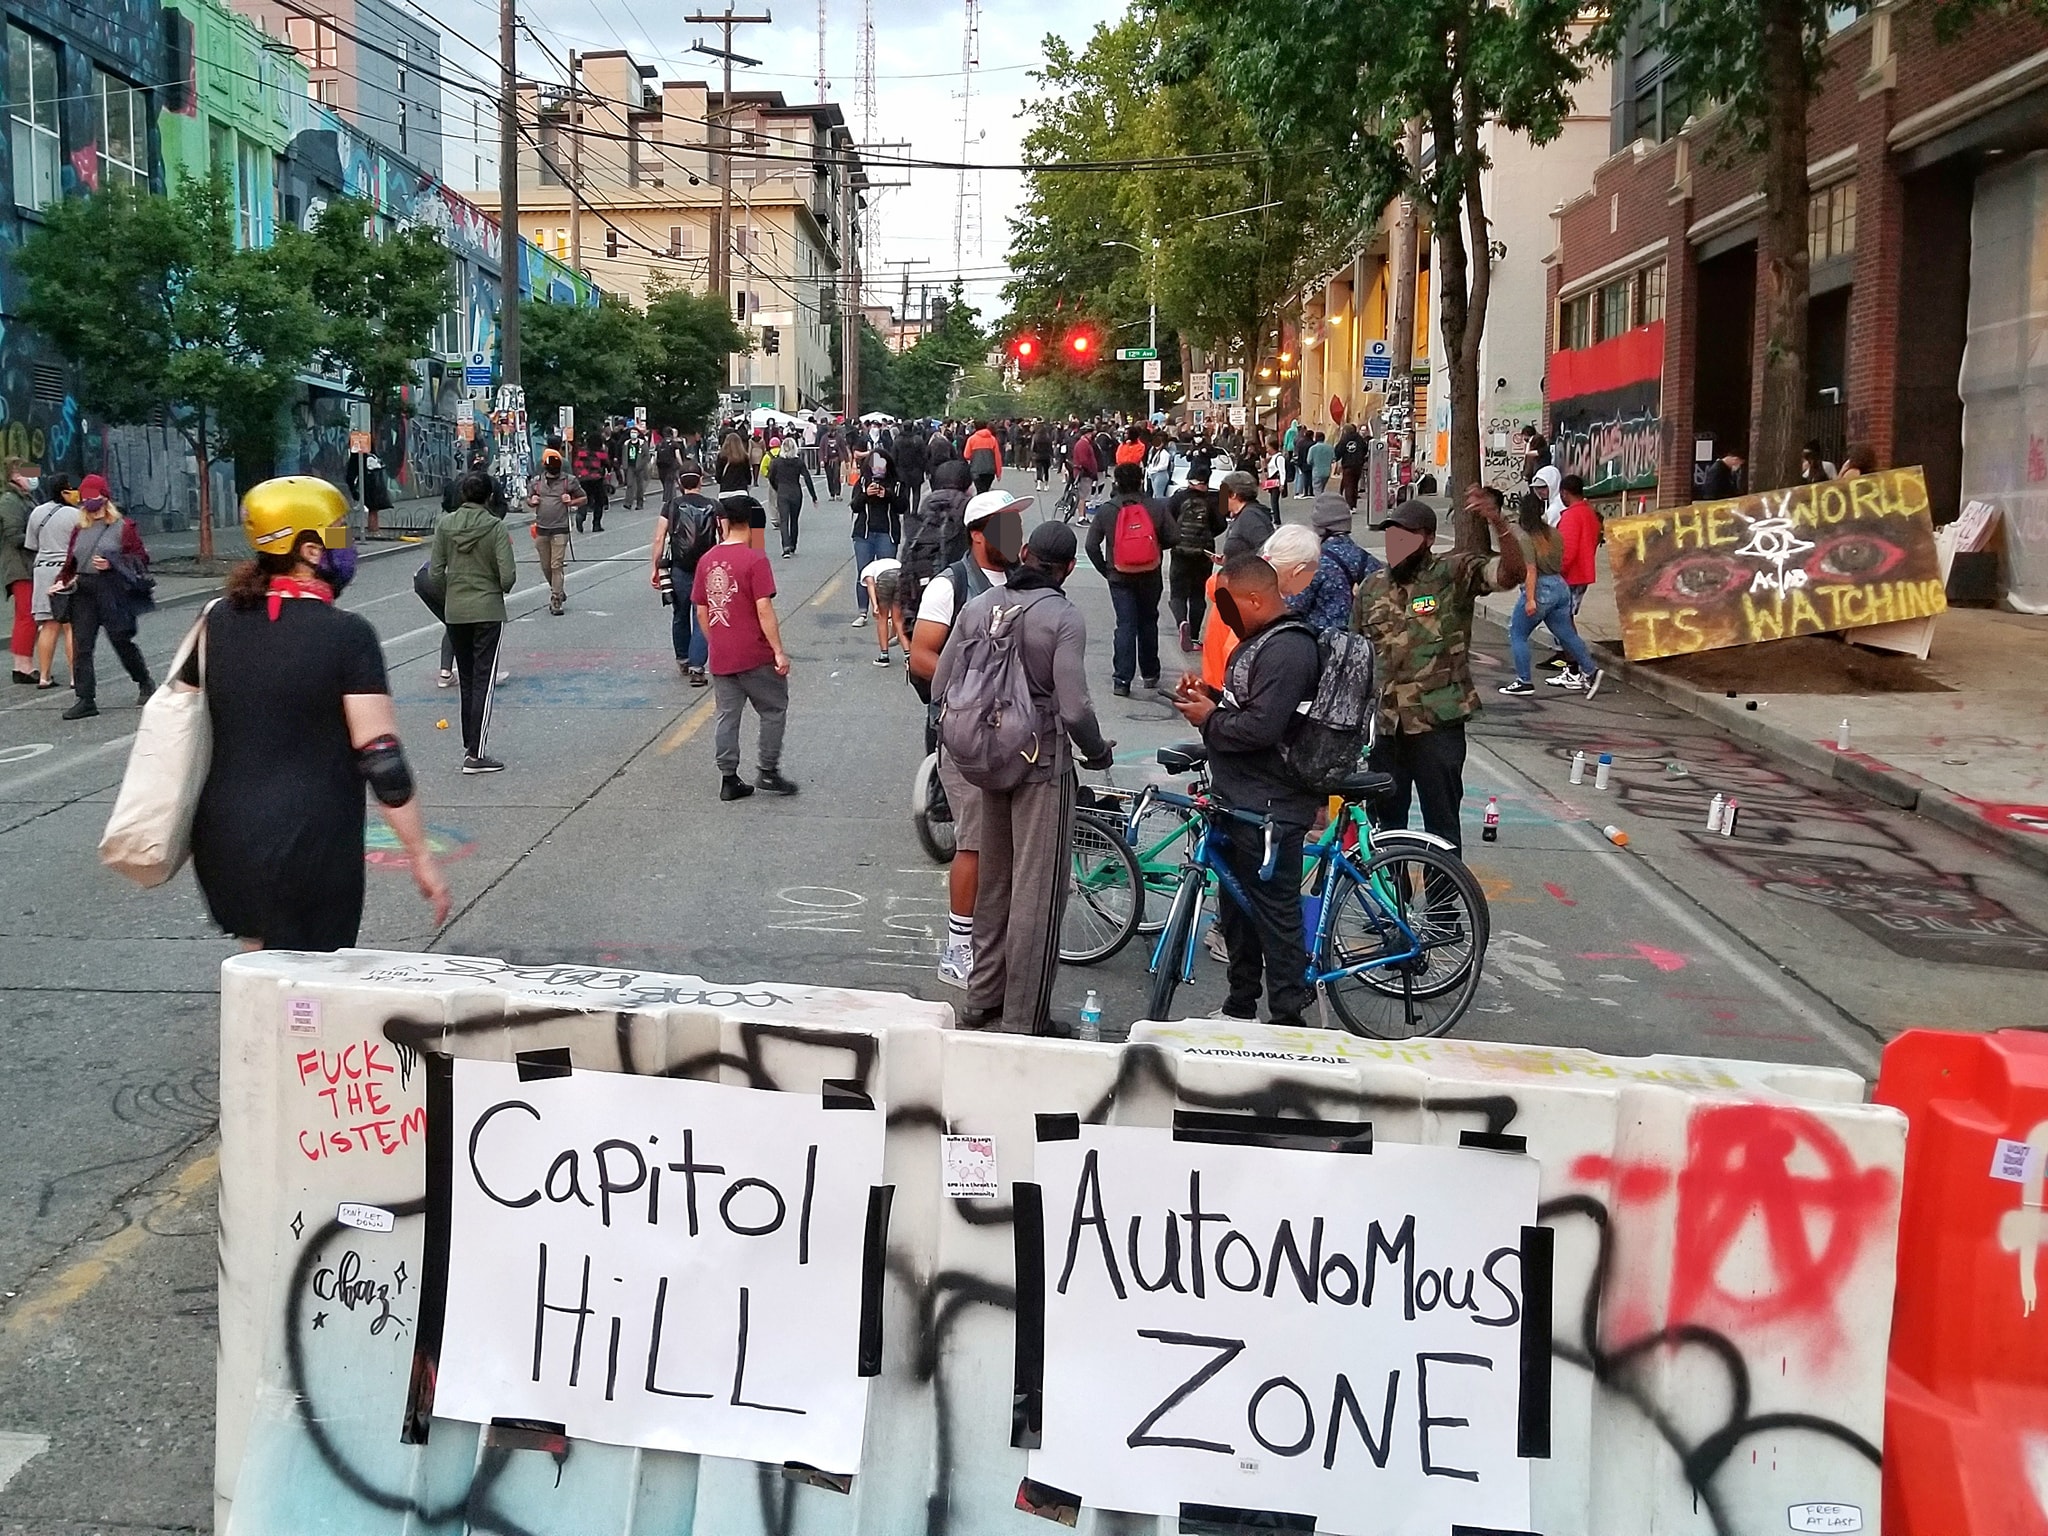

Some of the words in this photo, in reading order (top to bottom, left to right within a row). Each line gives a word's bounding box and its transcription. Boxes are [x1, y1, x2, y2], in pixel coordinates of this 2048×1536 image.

[1613, 503, 1739, 562] THE
[1775, 472, 1929, 529] WORLD
[1632, 608, 1704, 659] IS
[1742, 579, 1947, 643] WATCHING
[297, 1040, 394, 1086] FUCK
[1184, 1046, 1295, 1061] AUTONOMOUS
[1297, 1054, 1350, 1064] ZONE
[318, 1083, 391, 1119] THE
[299, 1107, 427, 1161] CISTEM
[469, 1100, 817, 1265] Capitol
[1127, 1328, 1493, 1482] ZONE
[1806, 1504, 1841, 1515] FREE
[1806, 1516, 1823, 1526] AT
[1827, 1517, 1857, 1527] LAST
